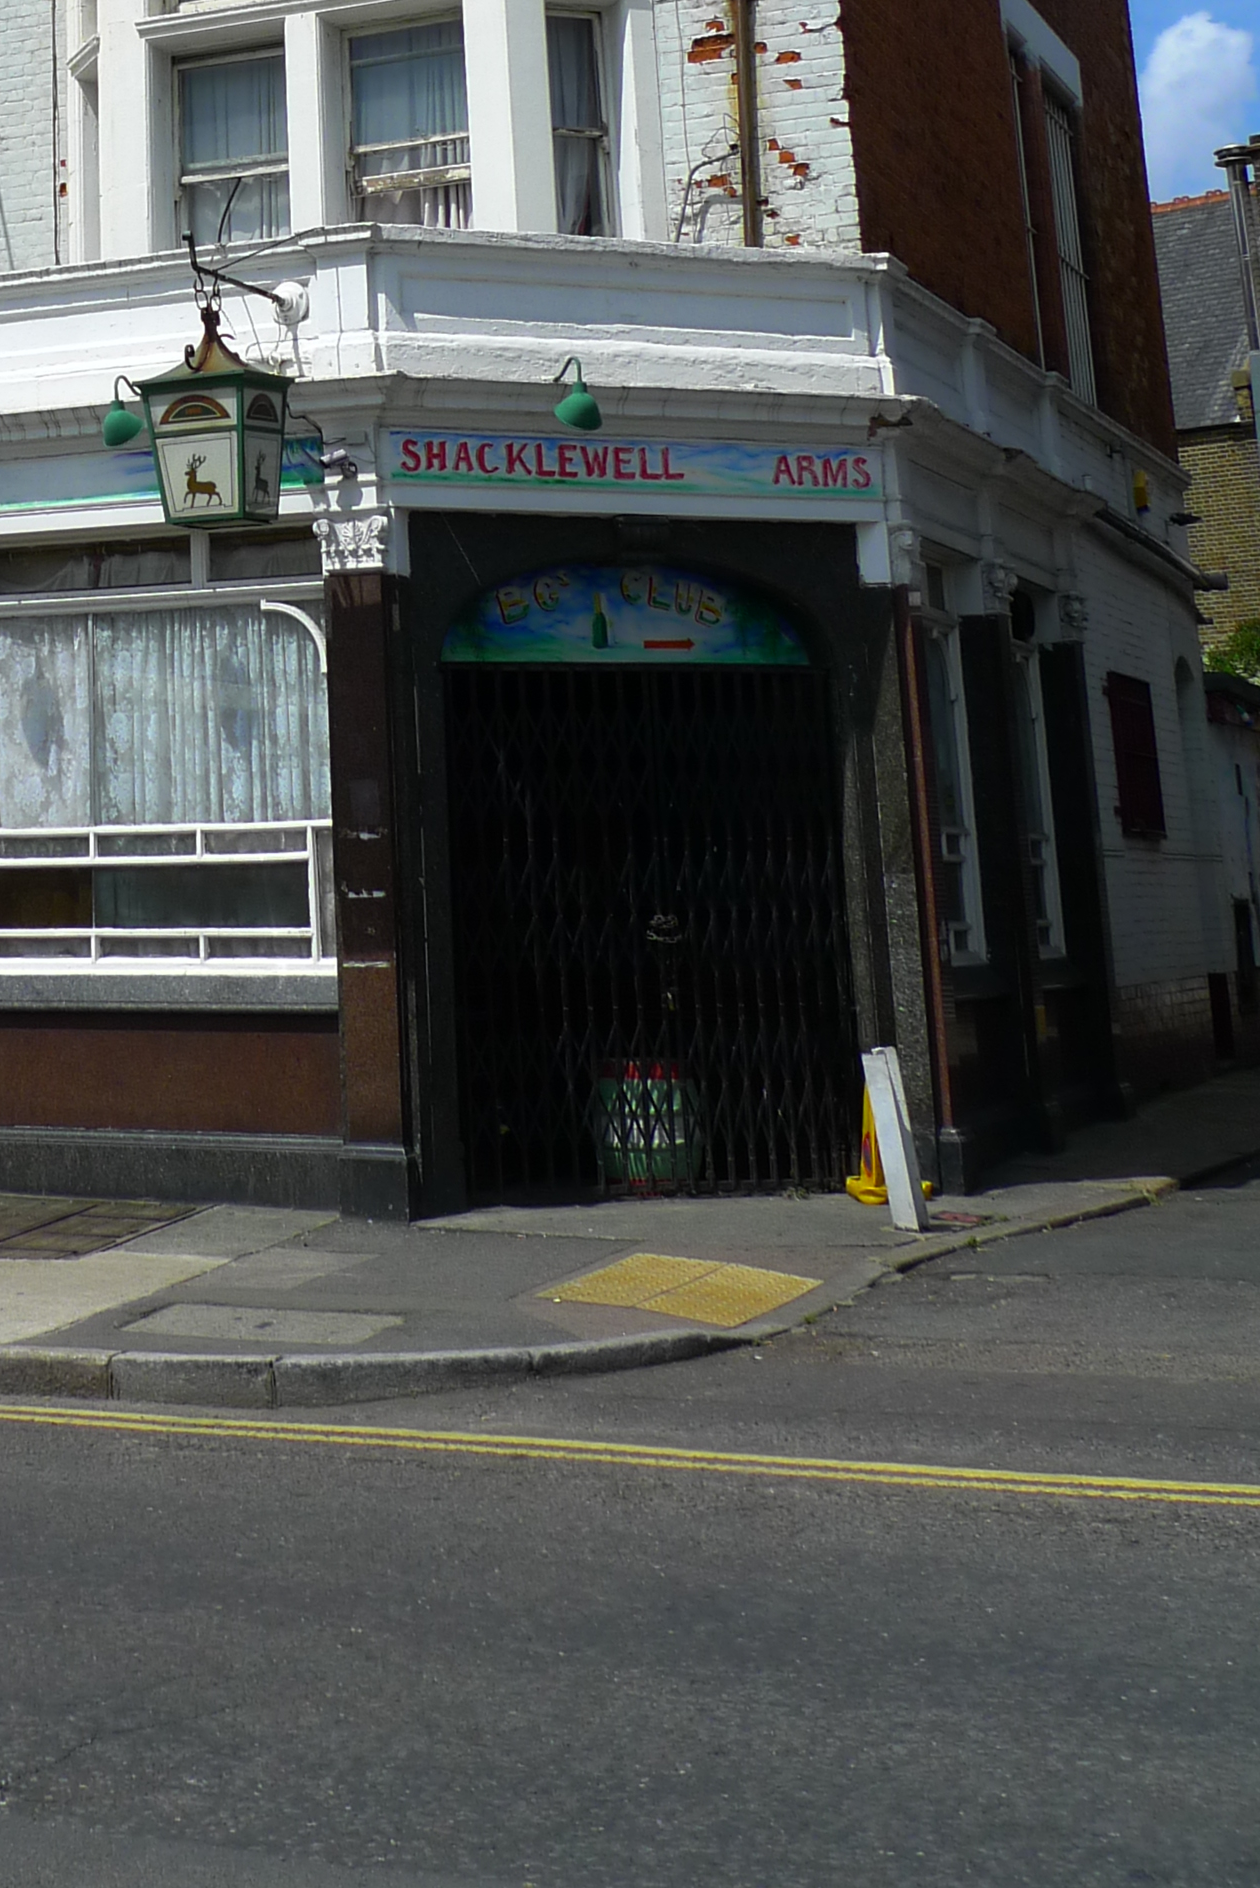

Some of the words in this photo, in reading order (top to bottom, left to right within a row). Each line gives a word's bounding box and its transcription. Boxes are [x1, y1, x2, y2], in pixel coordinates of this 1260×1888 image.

[400, 440, 685, 481] SHACKLEWELL
[771, 455, 873, 489] ARMS
[619, 567, 727, 629] CLUB
